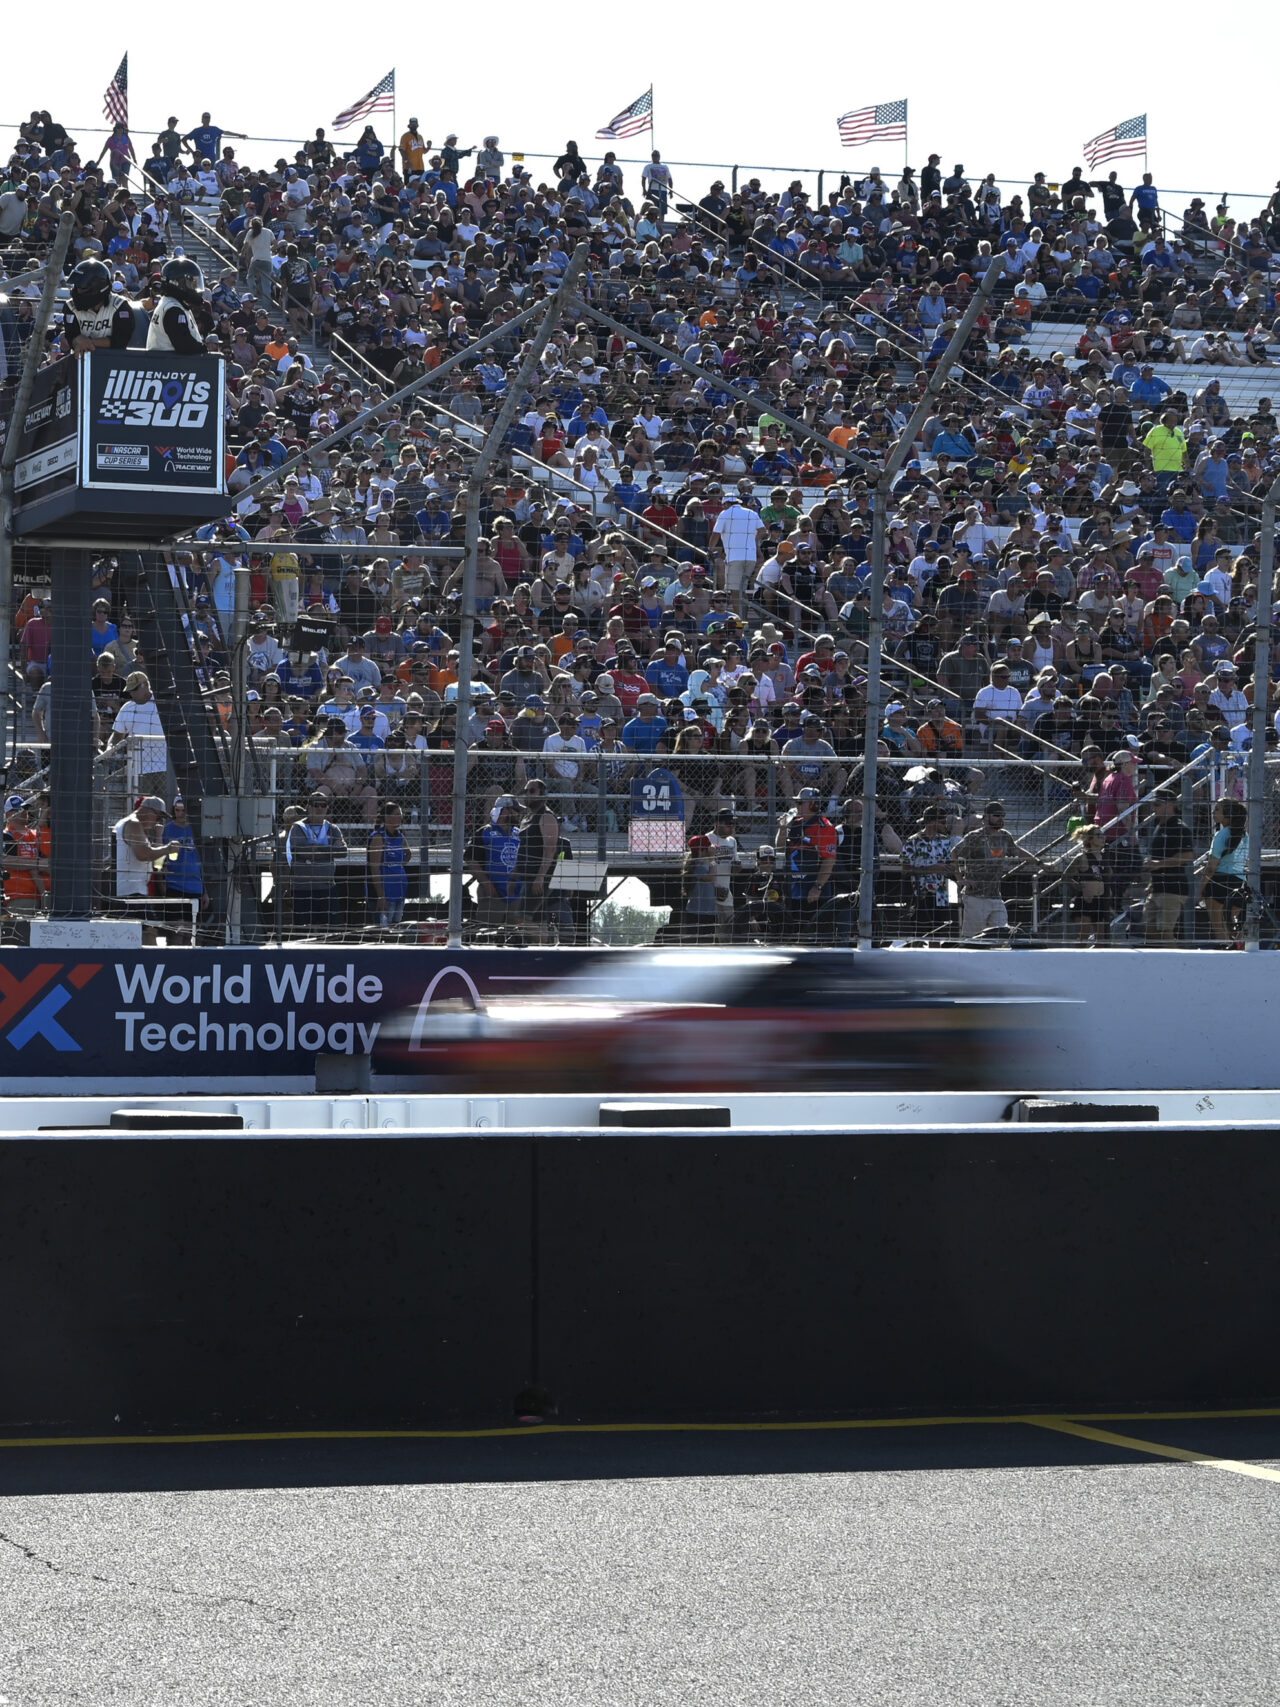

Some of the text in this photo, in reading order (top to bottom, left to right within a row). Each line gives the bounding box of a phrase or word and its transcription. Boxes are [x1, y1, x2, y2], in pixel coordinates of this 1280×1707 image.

[145, 371, 188, 380] ENJOY
[124, 401, 209, 428] 300
[113, 446, 142, 455] NASCAR
[196, 447, 213, 455] Wide
[104, 456, 143, 465] CUP SERIES
[177, 453, 212, 462] Technology
[642, 784, 671, 811] 34
[114, 963, 383, 1004] World Wide
[114, 1011, 381, 1055] Technology
